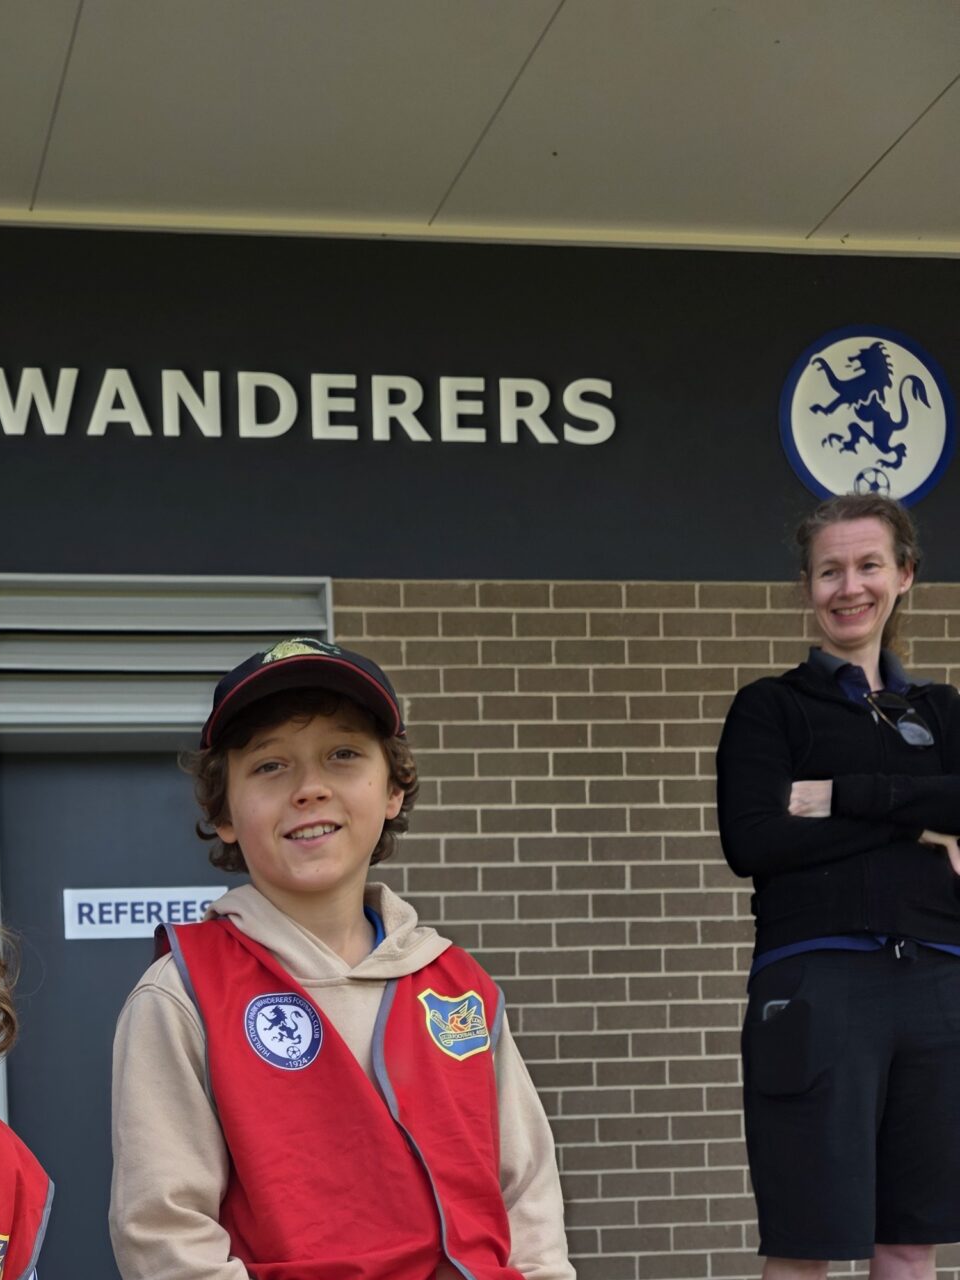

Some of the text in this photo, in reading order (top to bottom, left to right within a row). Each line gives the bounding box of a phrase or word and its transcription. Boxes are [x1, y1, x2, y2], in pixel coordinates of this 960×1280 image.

[256, 996, 293, 1008] WANDERERS
[312, 1020, 320, 1039] CLUB
[288, 1057, 308, 1068] 1924
